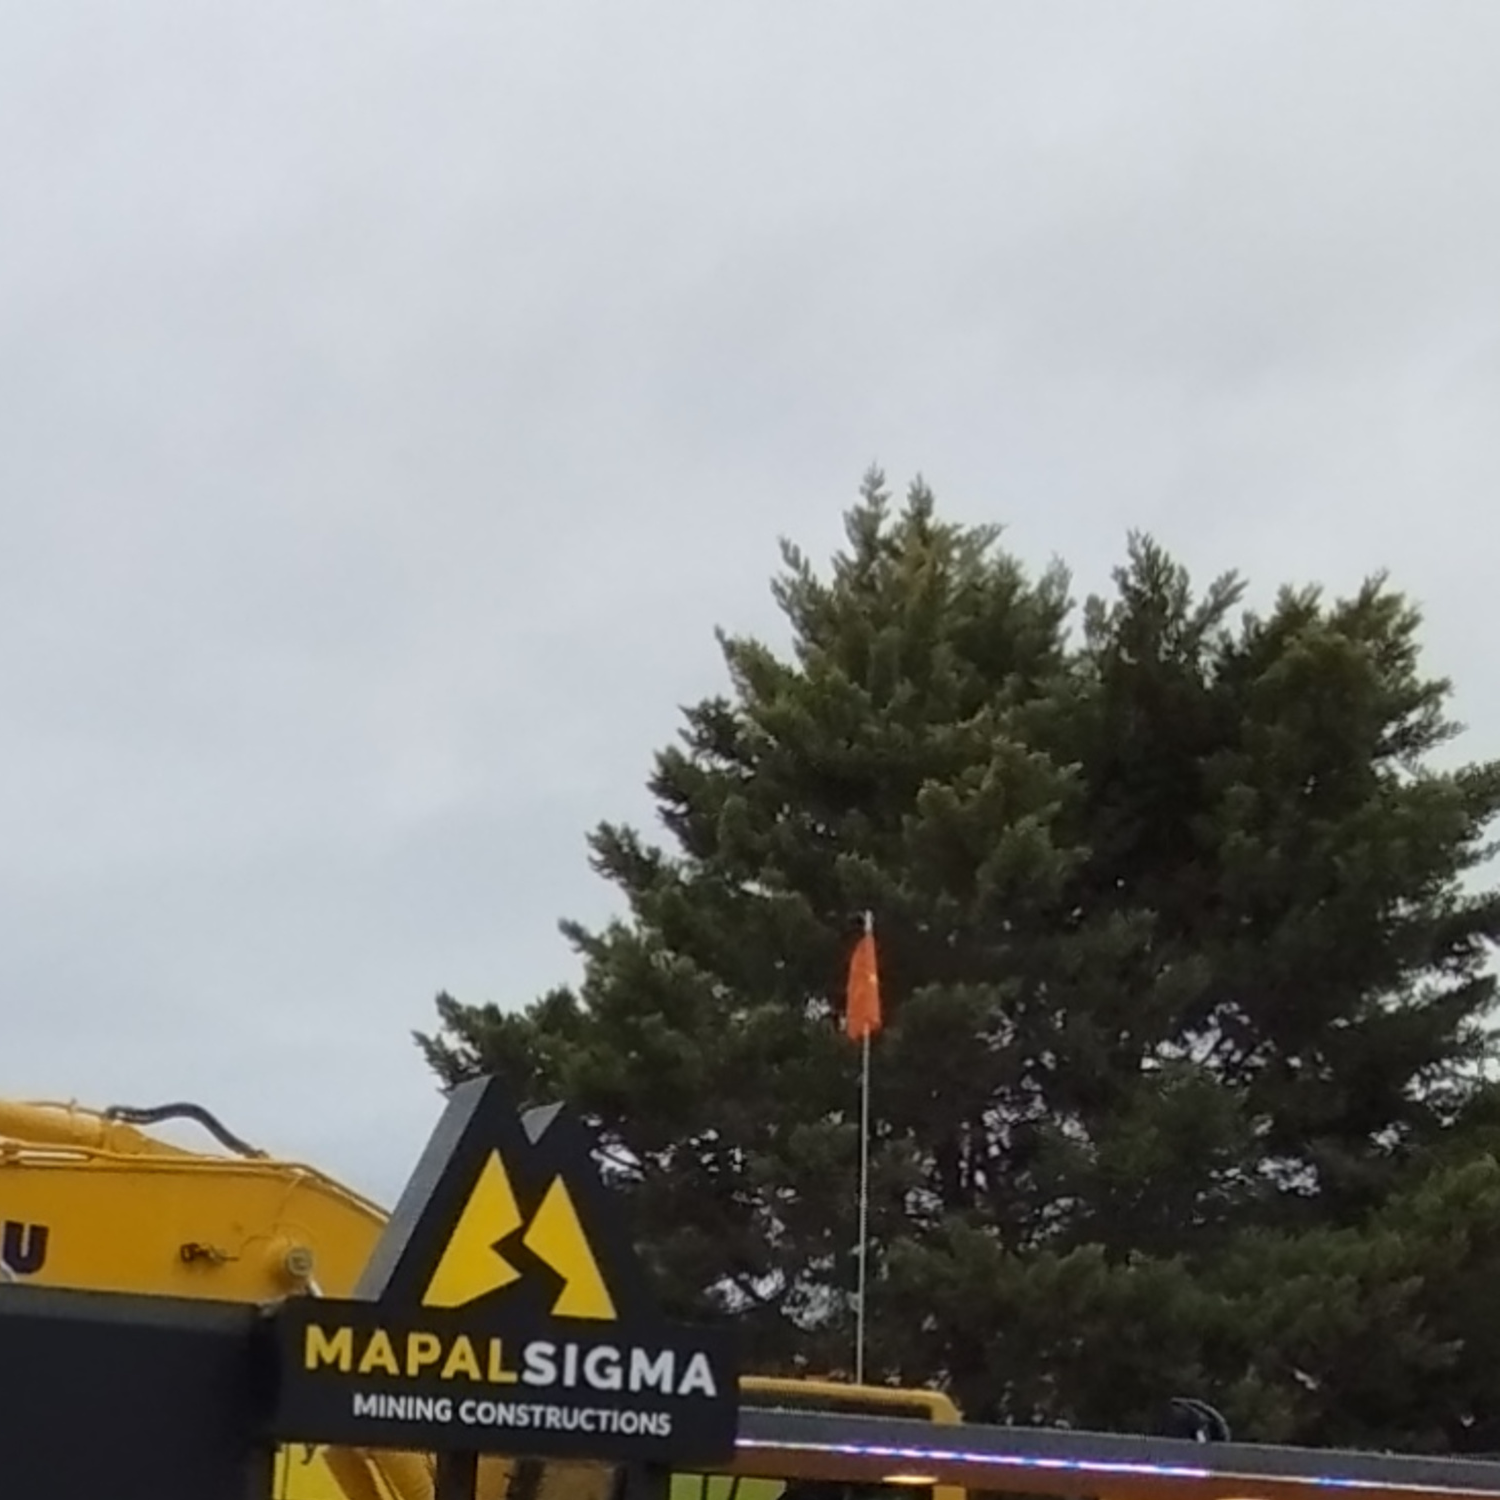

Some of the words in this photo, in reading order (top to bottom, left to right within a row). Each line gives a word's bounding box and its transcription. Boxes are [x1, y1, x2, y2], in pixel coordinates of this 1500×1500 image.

[305, 1324, 718, 1397] MAPALSIGMA
[353, 1393, 452, 1422] MINING
[459, 1399, 672, 1436] CONSTRUCTIONS
